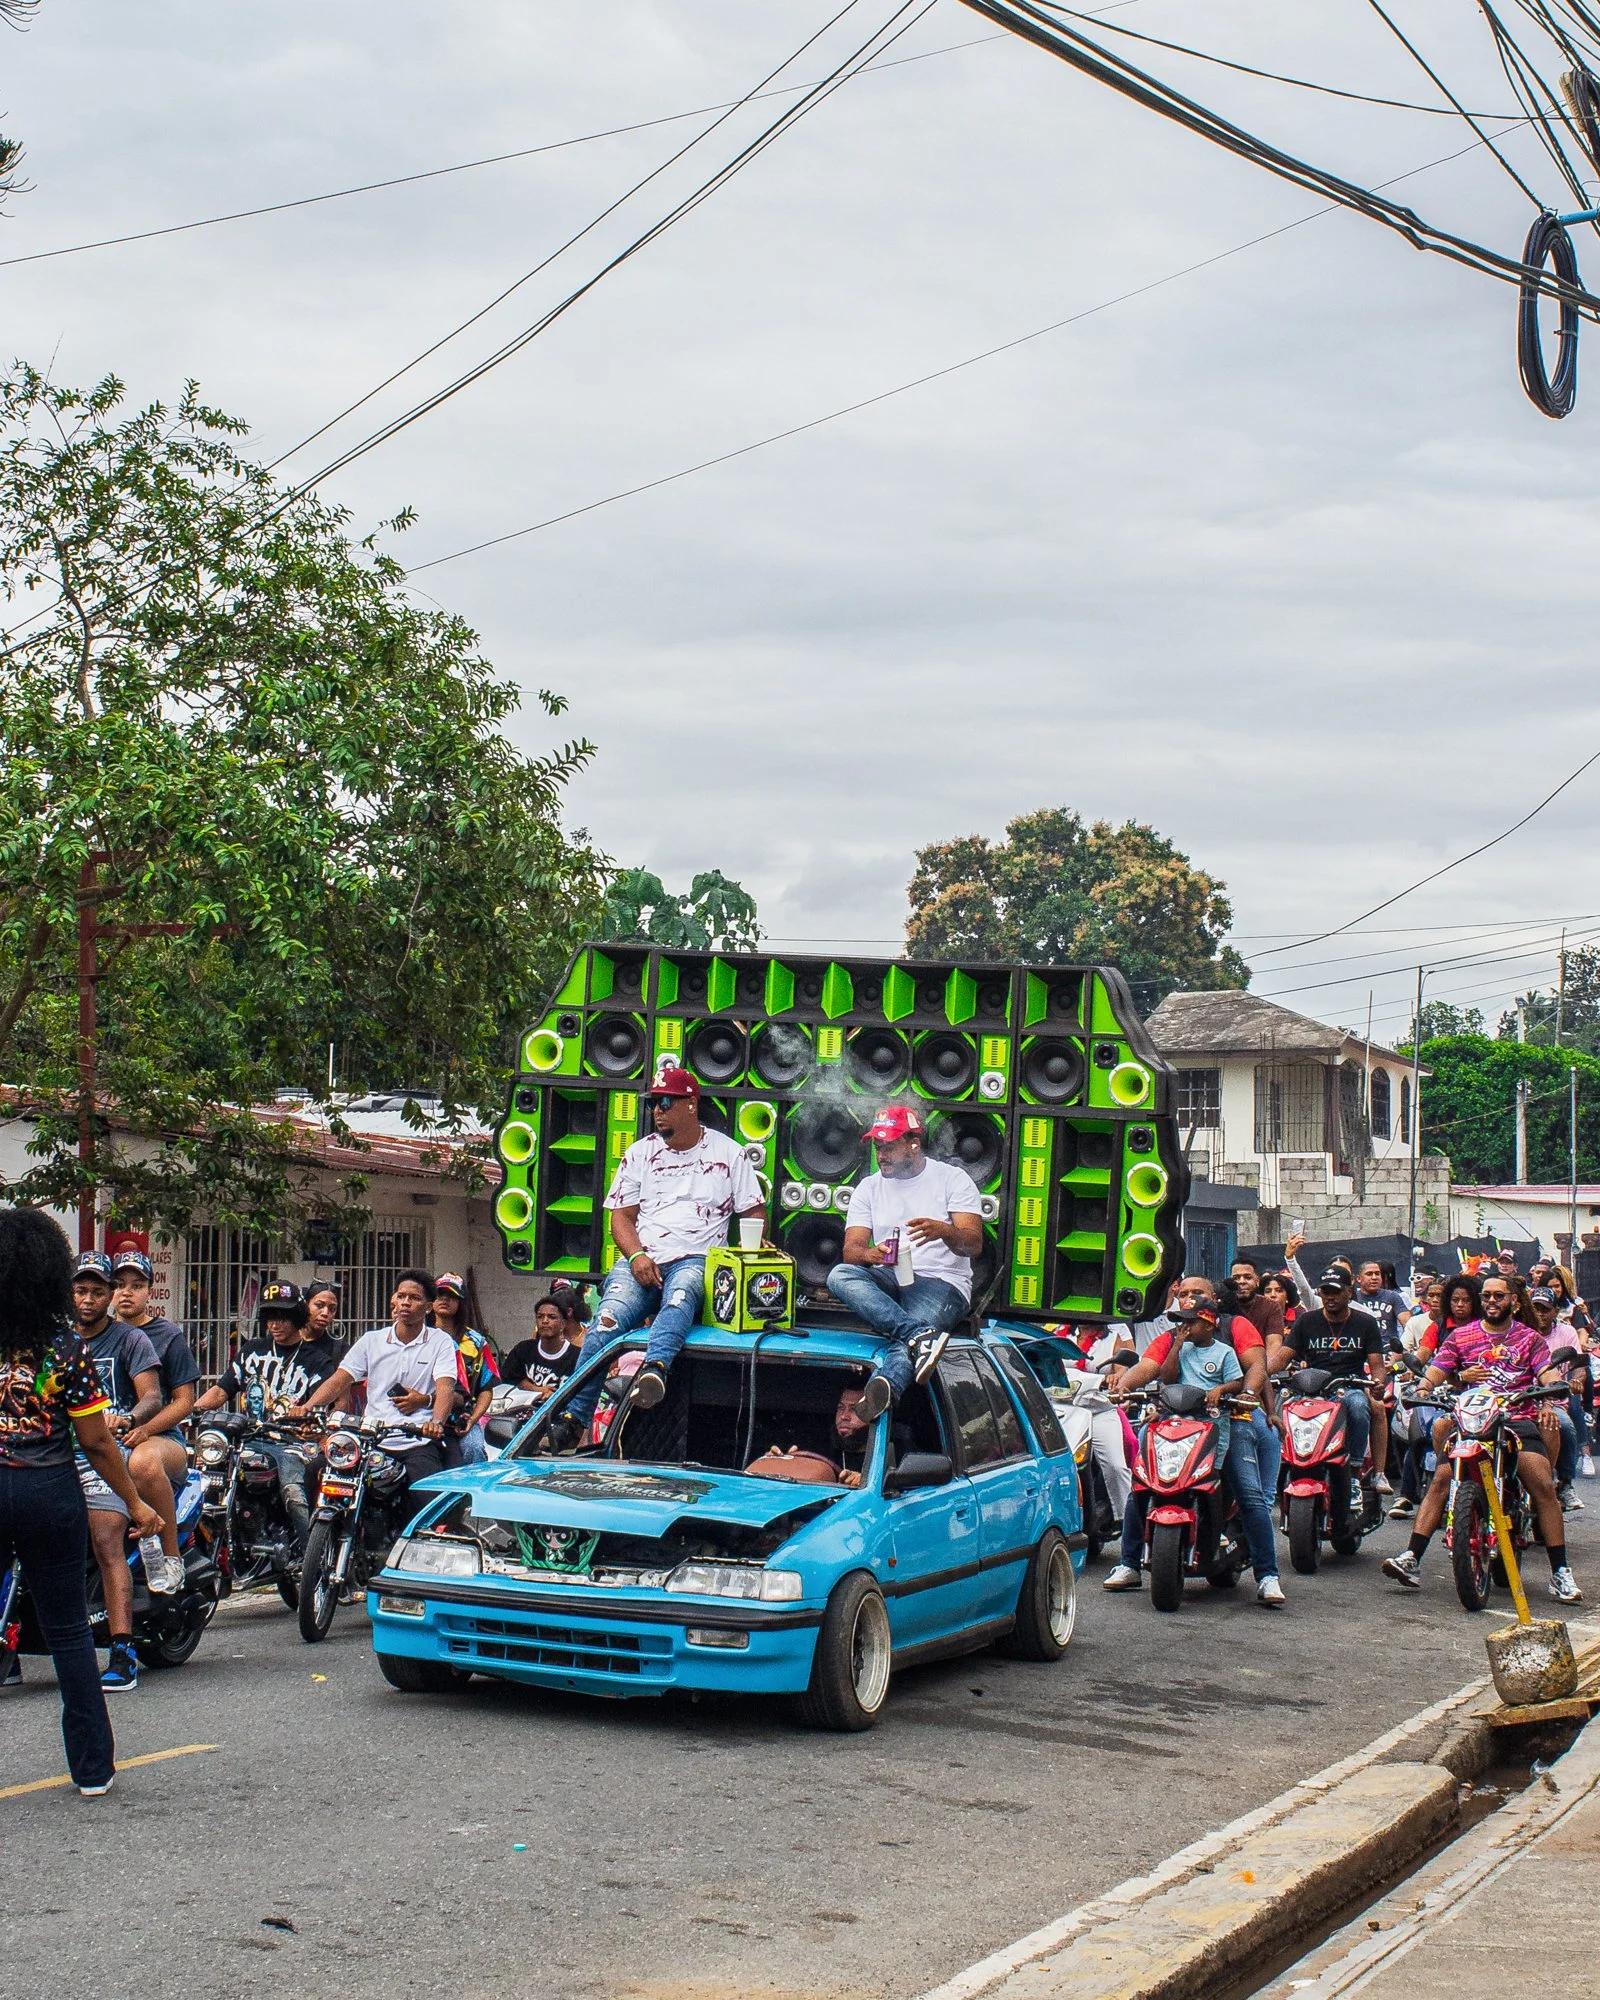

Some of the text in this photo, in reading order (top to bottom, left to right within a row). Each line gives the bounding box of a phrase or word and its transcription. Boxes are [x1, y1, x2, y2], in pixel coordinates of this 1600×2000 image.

[652, 1071, 667, 1088] R
[149, 1252, 172, 1264] LARES
[154, 1271, 166, 1283] ON
[269, 1285, 280, 1299] P
[1364, 1301, 1393, 1314] CAGO
[1308, 1336, 1364, 1350] MEZCAL
[1464, 1395, 1491, 1408] 13
